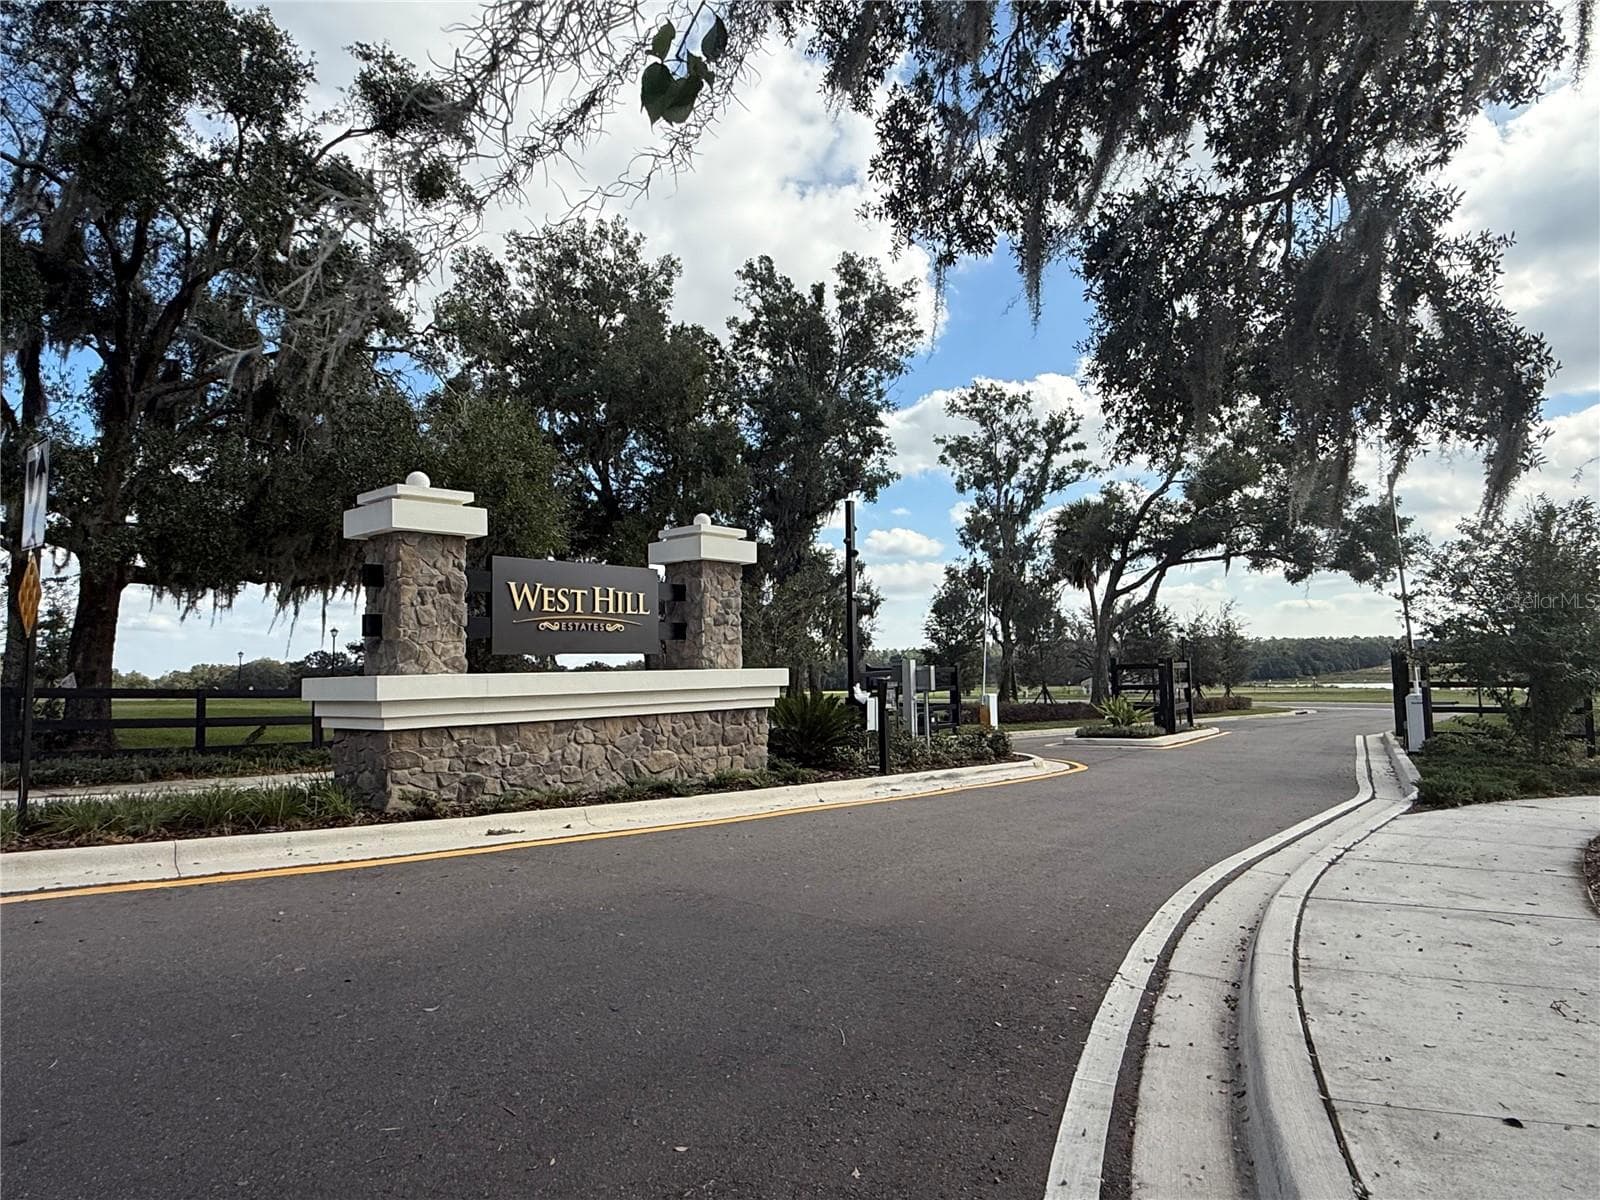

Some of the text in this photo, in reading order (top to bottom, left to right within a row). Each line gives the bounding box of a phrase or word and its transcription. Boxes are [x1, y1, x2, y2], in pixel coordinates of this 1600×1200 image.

[507, 581, 650, 615] WEST HILL
[561, 622, 606, 632] ESTATES
